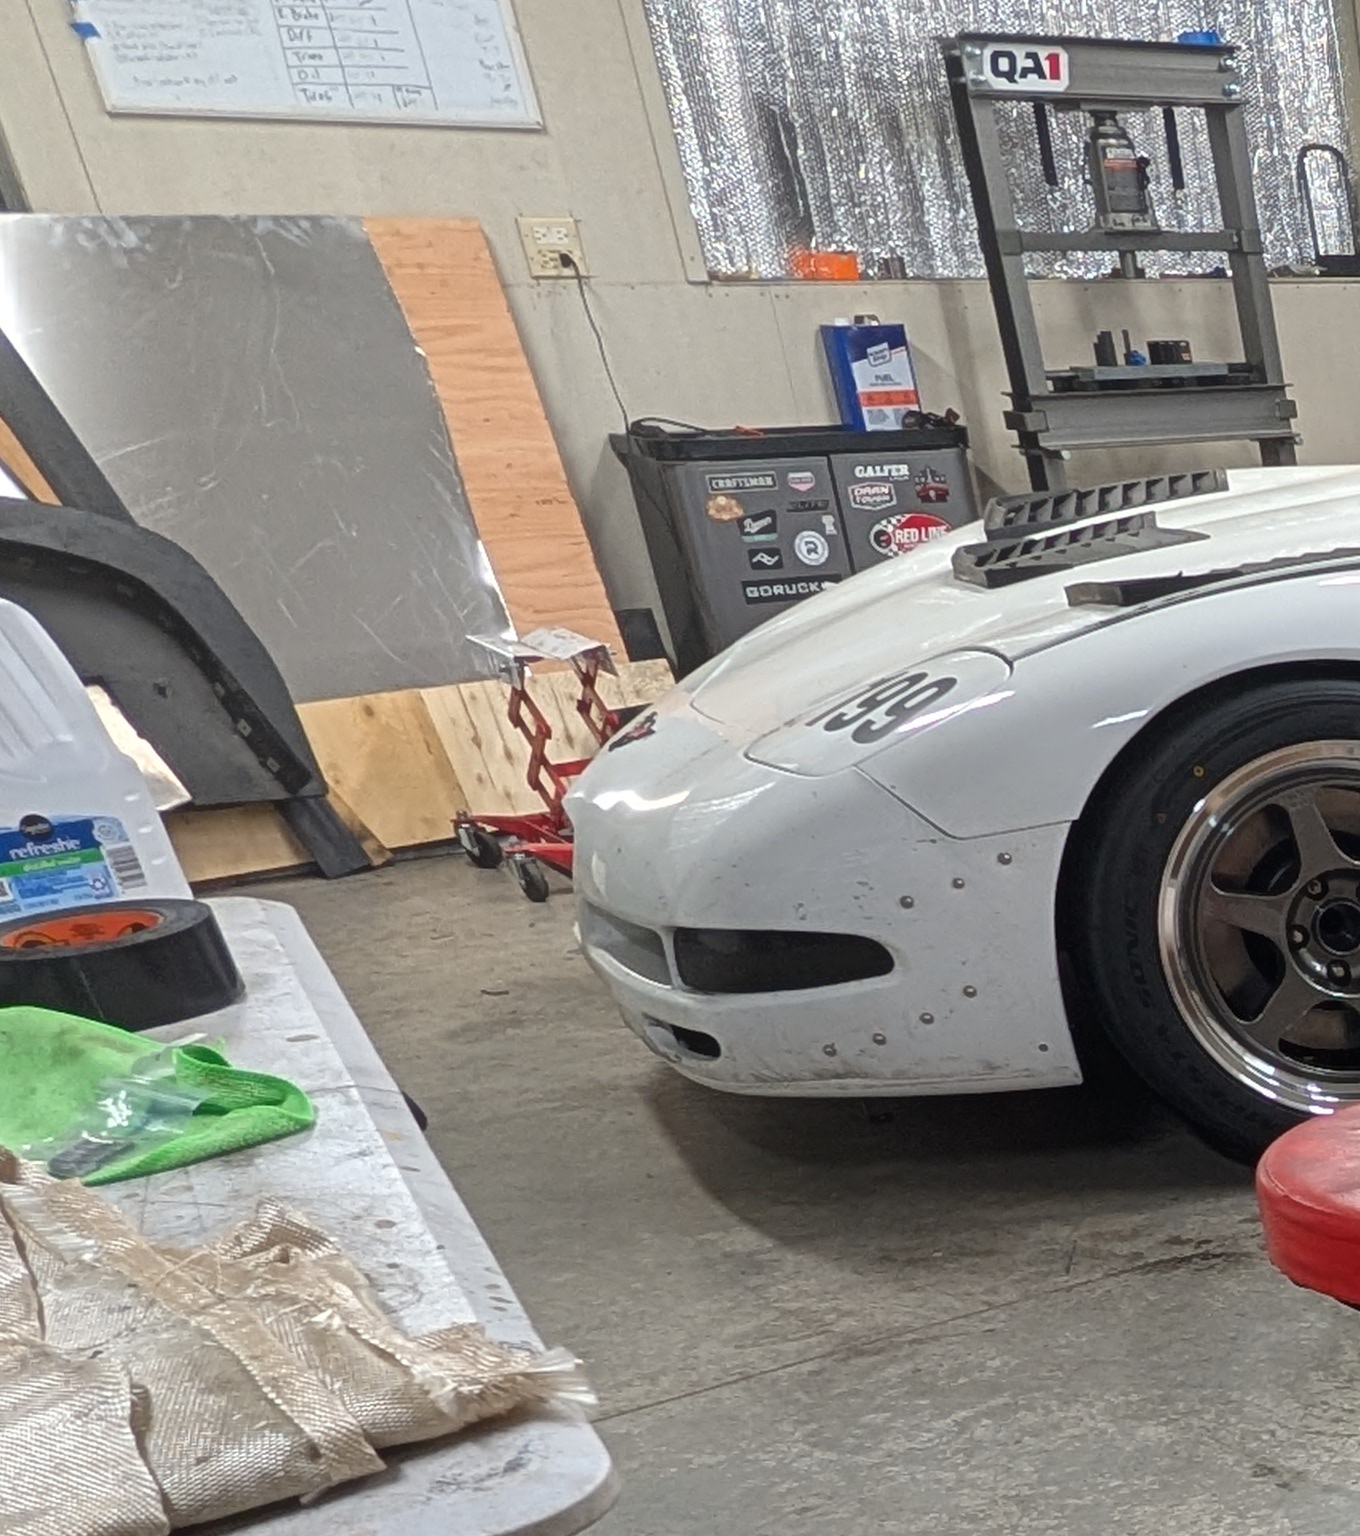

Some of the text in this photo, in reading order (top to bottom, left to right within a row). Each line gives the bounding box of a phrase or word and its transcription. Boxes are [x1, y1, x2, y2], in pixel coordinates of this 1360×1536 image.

[990, 50, 1061, 84] QA1
[854, 464, 910, 478] GALFER
[895, 527, 919, 544] RED
[746, 581, 820, 598] GORUCK
[803, 671, 958, 745] 199
